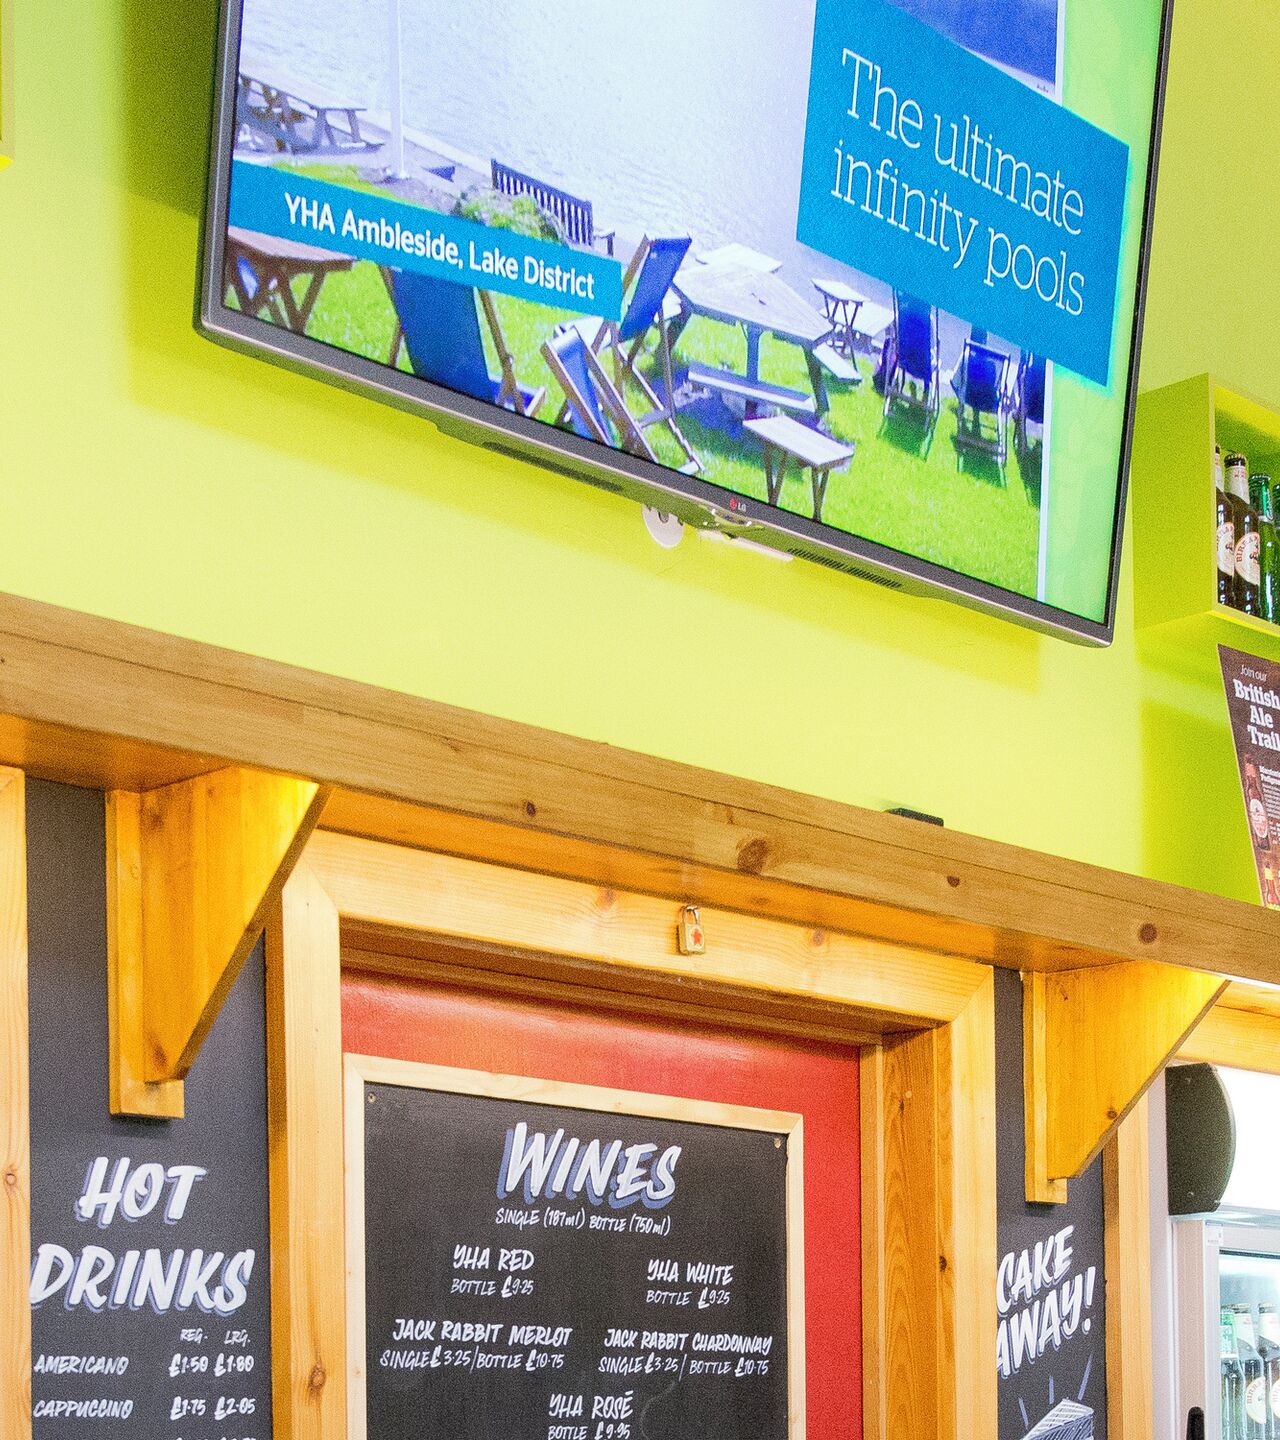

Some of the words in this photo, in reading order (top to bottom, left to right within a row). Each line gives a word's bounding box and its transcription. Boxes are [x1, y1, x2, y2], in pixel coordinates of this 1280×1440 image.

[841, 45, 925, 152] The
[933, 109, 1086, 237] ultimate
[830, 145, 980, 267] infinity
[983, 232, 1086, 319] pools
[284, 193, 338, 238] YHA
[341, 211, 464, 270] Ambleside,
[468, 236, 520, 284] Lake
[523, 253, 597, 302] District
[1233, 679, 1280, 710] British
[1250, 705, 1273, 728] Ale
[496, 1122, 682, 1209] WINES
[76, 1157, 207, 1228] HOT
[495, 1207, 539, 1229] SINGLE
[543, 1207, 586, 1229] (187ml)
[590, 1215, 627, 1232] BOTTLE
[629, 1215, 671, 1235] (750ml)
[454, 1244, 489, 1271] YHA
[498, 1249, 535, 1271] RED
[996, 1224, 1074, 1317] CAKE
[30, 1243, 255, 1316] DRINKS
[647, 1259, 679, 1283] YHA
[687, 1262, 734, 1285] WHITE
[451, 1278, 496, 1296] BOTTLE
[501, 1277, 534, 1298] £9.25
[646, 1290, 691, 1306] BOTTLE
[698, 1287, 731, 1309] £9.25
[393, 1319, 434, 1341] JACK
[441, 1322, 503, 1343] RABBIT
[509, 1325, 573, 1347] MERLOT
[996, 1266, 1096, 1378] AWAY!
[604, 1329, 636, 1348] JACK
[641, 1332, 688, 1351] RABBIT
[692, 1334, 773, 1355] CHARDONNAY
[34, 1355, 129, 1375] AMERICANO
[169, 1354, 208, 1377] £1.50
[215, 1354, 254, 1377] £1.80
[380, 1350, 430, 1368] SINGLE
[525, 1353, 565, 1371] £10.75
[598, 1358, 644, 1375] SINGLE
[689, 1360, 731, 1375] BOTTLE
[735, 1359, 769, 1377] £10.75
[33, 1399, 133, 1418] CAPPUCCINO
[170, 1397, 206, 1420] £1.75
[215, 1397, 256, 1420] £2.05
[549, 1394, 583, 1417] YHA
